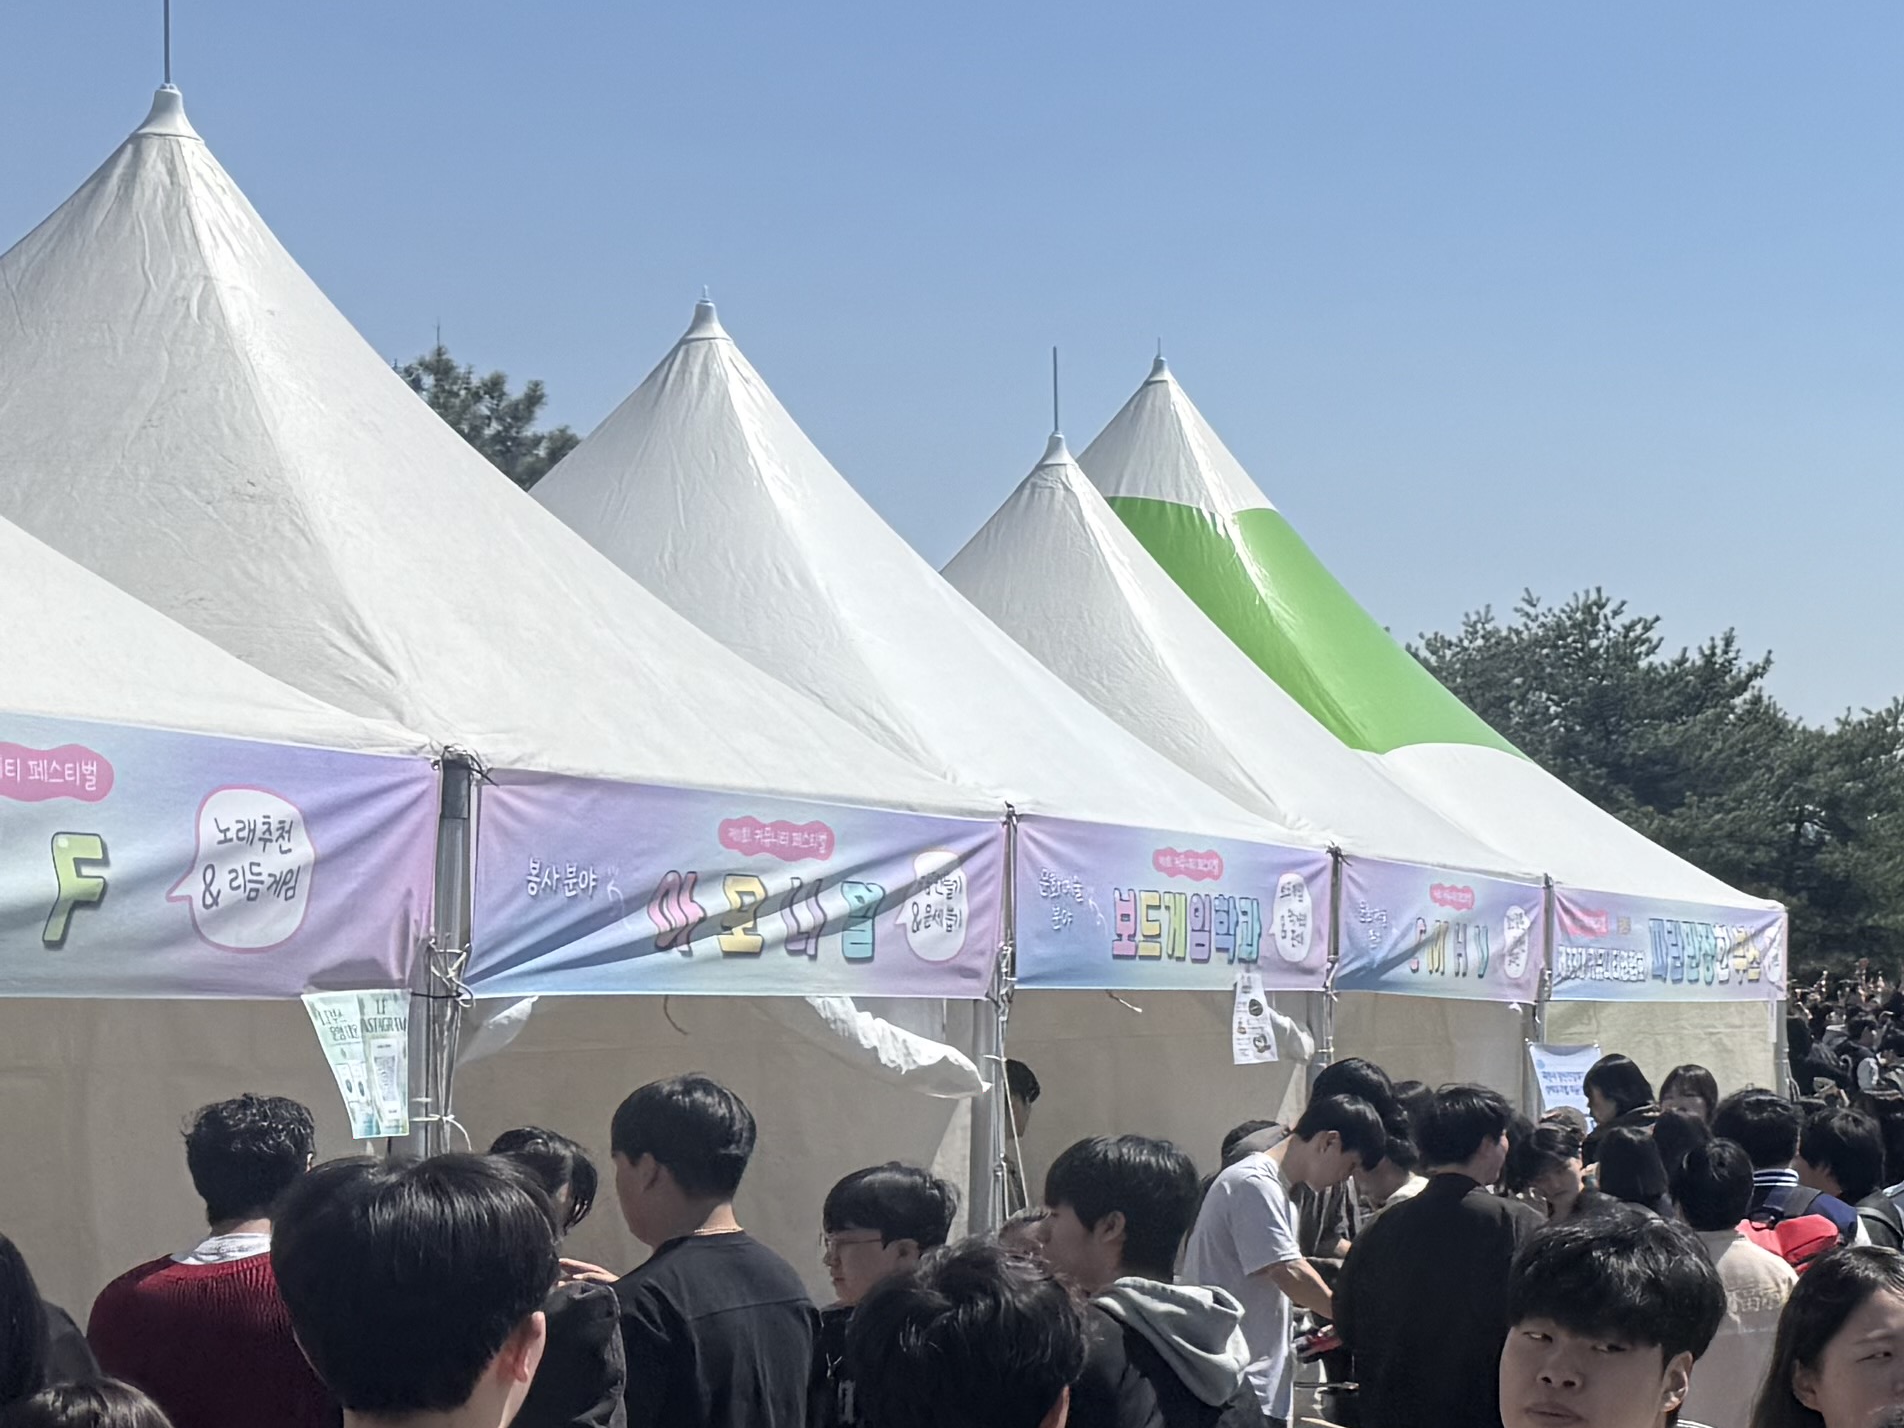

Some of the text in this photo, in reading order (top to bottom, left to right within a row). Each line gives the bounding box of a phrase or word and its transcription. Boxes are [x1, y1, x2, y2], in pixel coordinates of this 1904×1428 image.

[28, 759, 97, 791] 페스티벌
[213, 815, 293, 854] 노래추천
[43, 831, 109, 950] F
[202, 861, 301, 910] & 리듬게임
[526, 857, 598, 897] 봉사 분야
